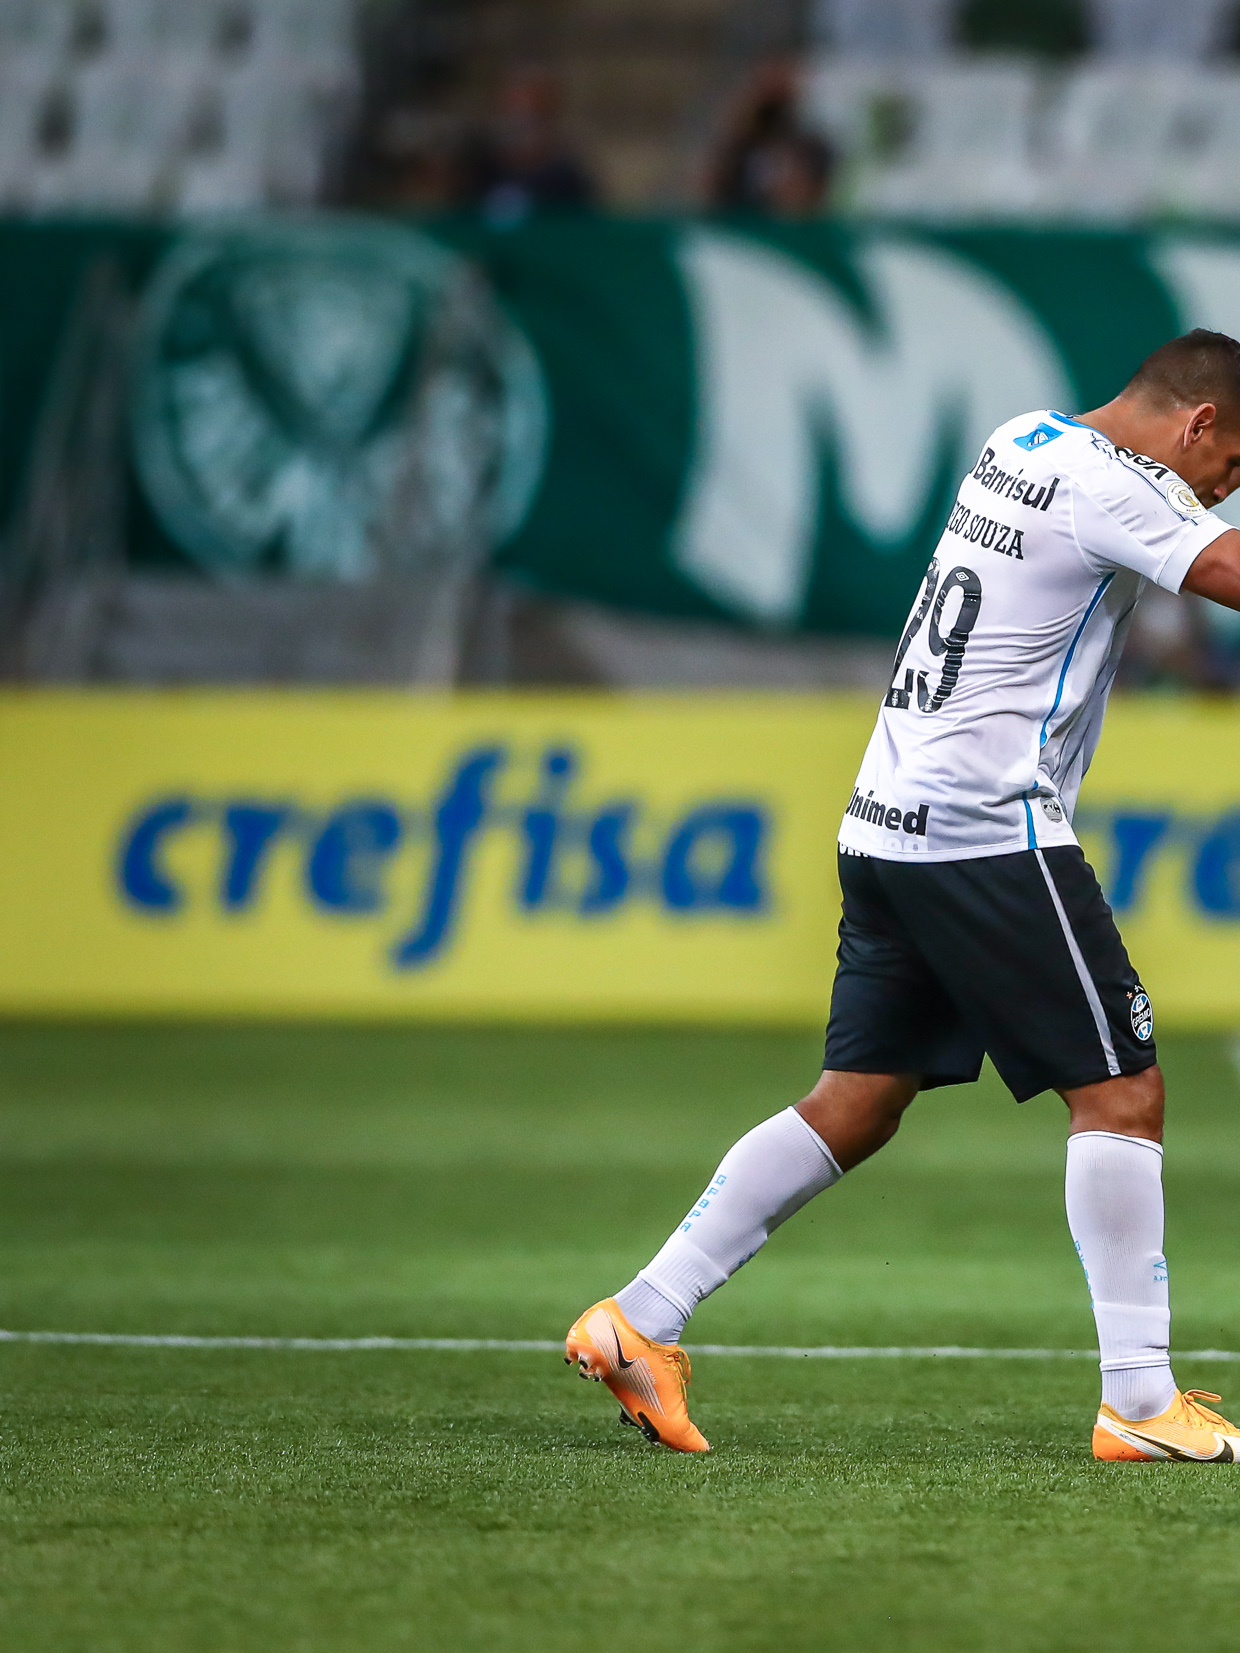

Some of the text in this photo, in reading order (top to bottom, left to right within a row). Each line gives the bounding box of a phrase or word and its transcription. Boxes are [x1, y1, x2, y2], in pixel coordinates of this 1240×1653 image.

[973, 447, 1060, 511] Banrisul
[963, 514, 1025, 560] SOUZA
[885, 556, 982, 713] 29
[114, 742, 772, 968] crefisa
